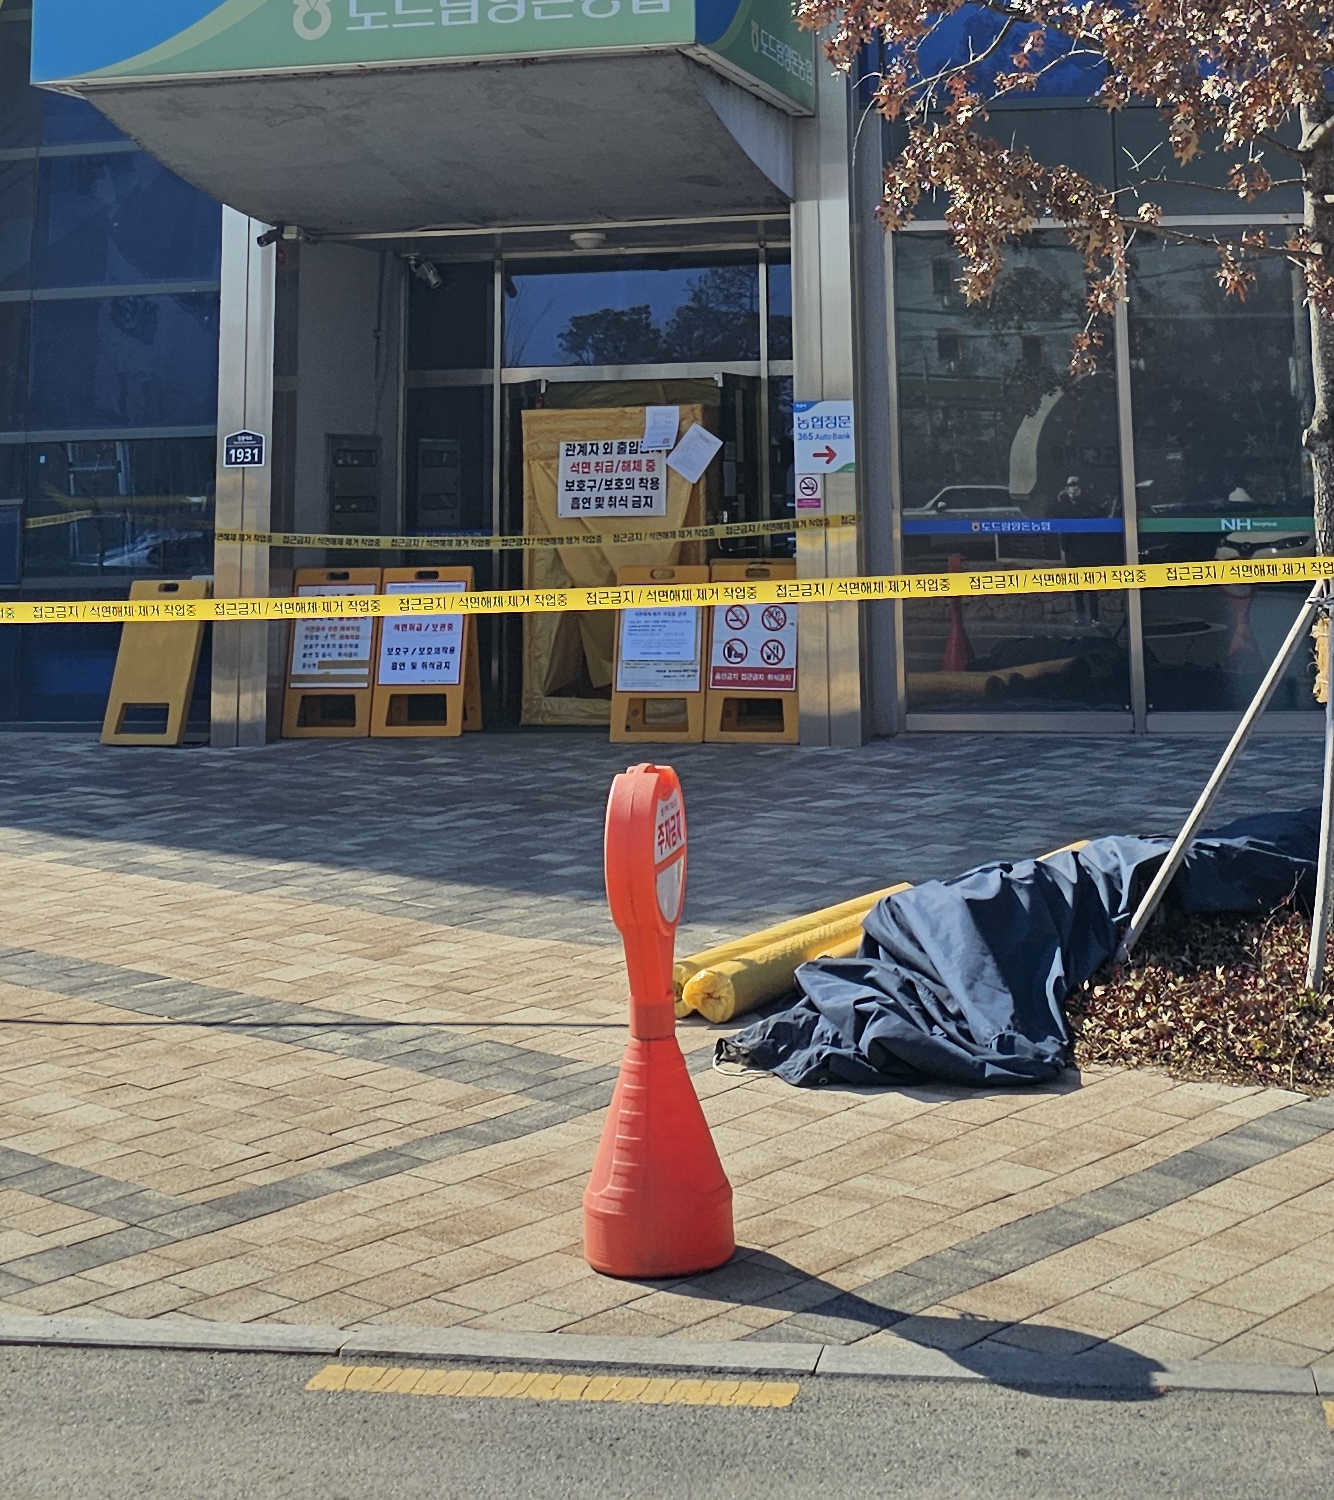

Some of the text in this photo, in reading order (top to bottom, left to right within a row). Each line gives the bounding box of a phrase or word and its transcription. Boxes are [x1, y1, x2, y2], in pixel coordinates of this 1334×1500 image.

[797, 415, 851, 430] 농협정문
[797, 432, 851, 441] 365 Auto Bank
[229, 448, 259, 463] 1931
[565, 442, 599, 457] 관계자
[603, 442, 613, 457] 외
[570, 461, 591, 475] 석면
[645, 459, 656, 473] 중
[638, 477, 660, 491] 착용
[570, 495, 653, 510] 흡연 및 취식 금지
[981, 521, 1051, 532] 도드람양돈농협
[1221, 519, 1252, 531] NH
[969, 575, 1019, 589] 접근금지
[1111, 569, 1147, 584] 작업중
[1166, 567, 1216, 581] 접근금지
[586, 591, 635, 605] 접근금지
[723, 586, 757, 600] 작업중
[776, 583, 825, 598] 접근금지
[916, 578, 950, 592] 작업중
[214, 602, 261, 616] 접근금지
[348, 600, 381, 612] 작업중
[398, 597, 446, 611] 접근금지
[534, 593, 568, 607] 작업중
[32, 605, 78, 619] 접근금지
[164, 604, 197, 617] 작업중
[387, 647, 409, 656] 보호구
